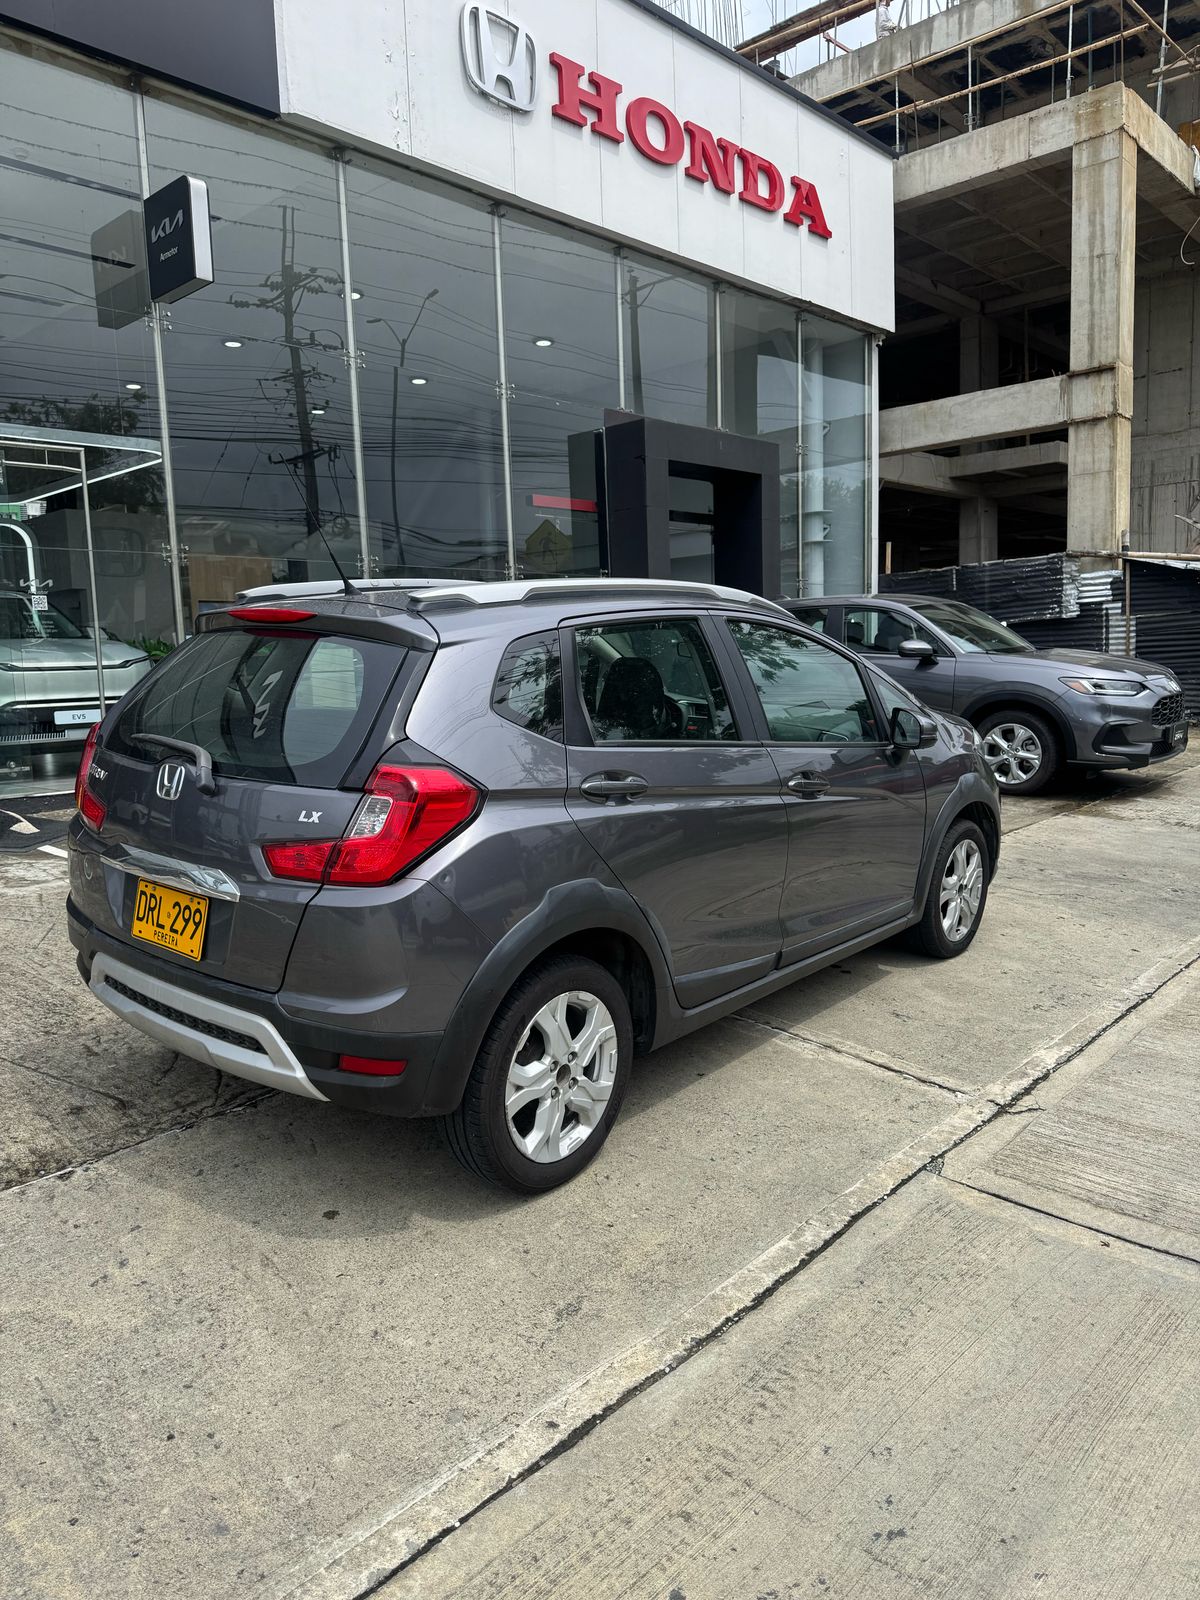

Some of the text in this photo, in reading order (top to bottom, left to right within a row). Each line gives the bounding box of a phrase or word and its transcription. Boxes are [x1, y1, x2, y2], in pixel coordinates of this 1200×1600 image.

[549, 51, 832, 240] HONDA
[151, 209, 184, 243] KIA
[160, 246, 179, 262] Armotor
[298, 810, 324, 824] LX
[135, 889, 203, 941] DRL 299
[153, 929, 179, 947] PEREIRA
